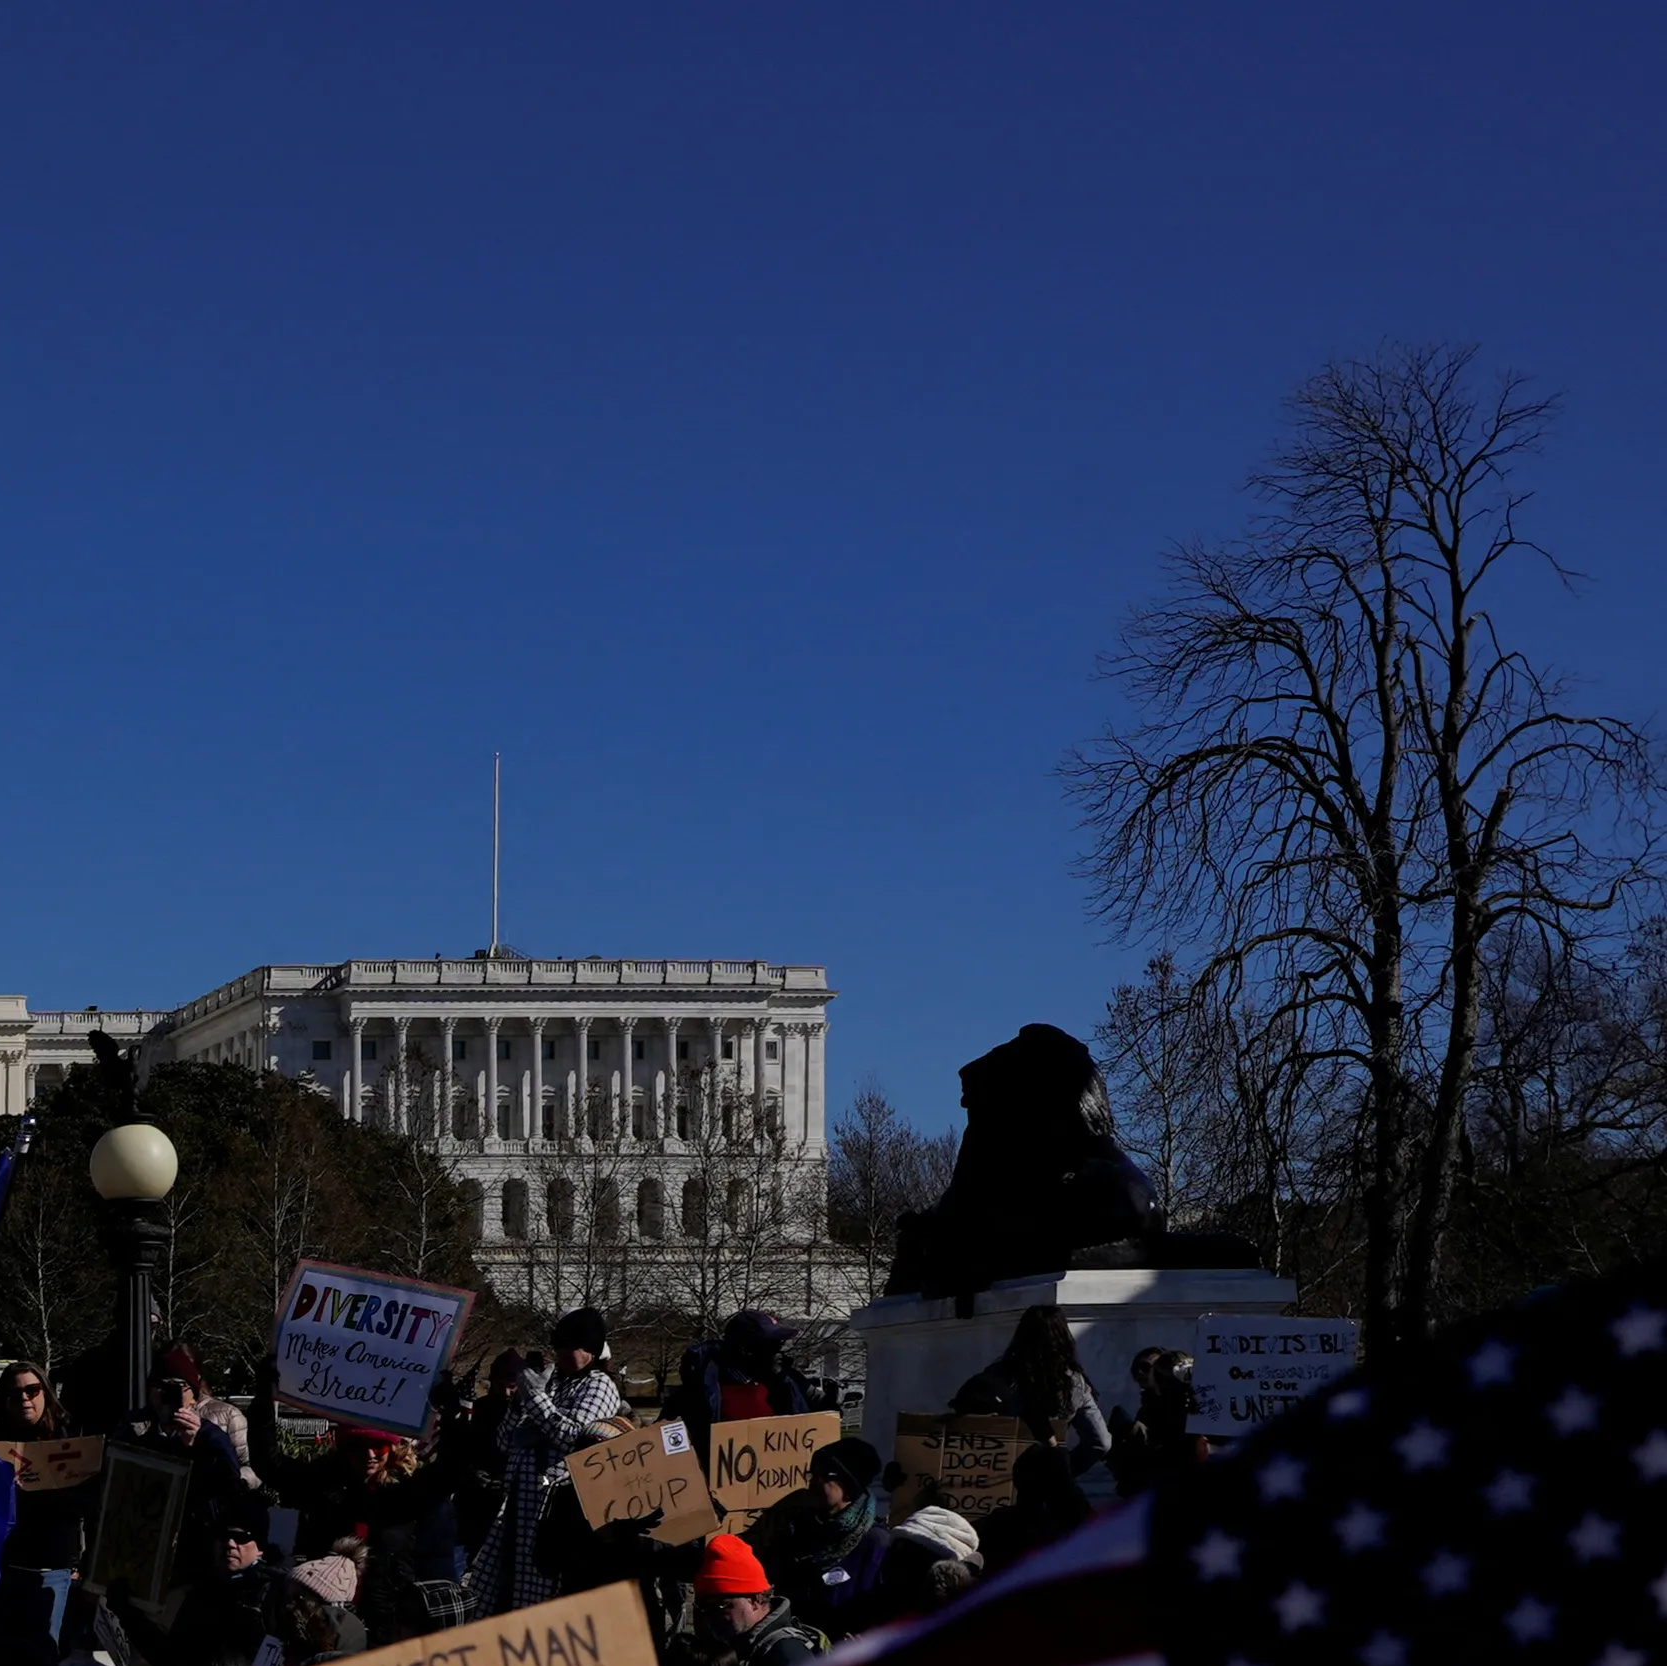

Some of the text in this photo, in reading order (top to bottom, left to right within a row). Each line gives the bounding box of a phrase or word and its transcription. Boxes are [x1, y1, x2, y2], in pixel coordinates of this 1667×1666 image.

[291, 1284, 452, 1348] DIVERSITY
[1207, 1332, 1355, 1355] INDIVISIBLE
[298, 1361, 407, 1406] Great!
[717, 1428, 817, 1488] NO KING
[942, 1452, 1008, 1471] DOGE
[756, 1465, 809, 1495] KIDDIN
[915, 1473, 989, 1488] TO THE
[943, 1493, 1011, 1512] DOGS
